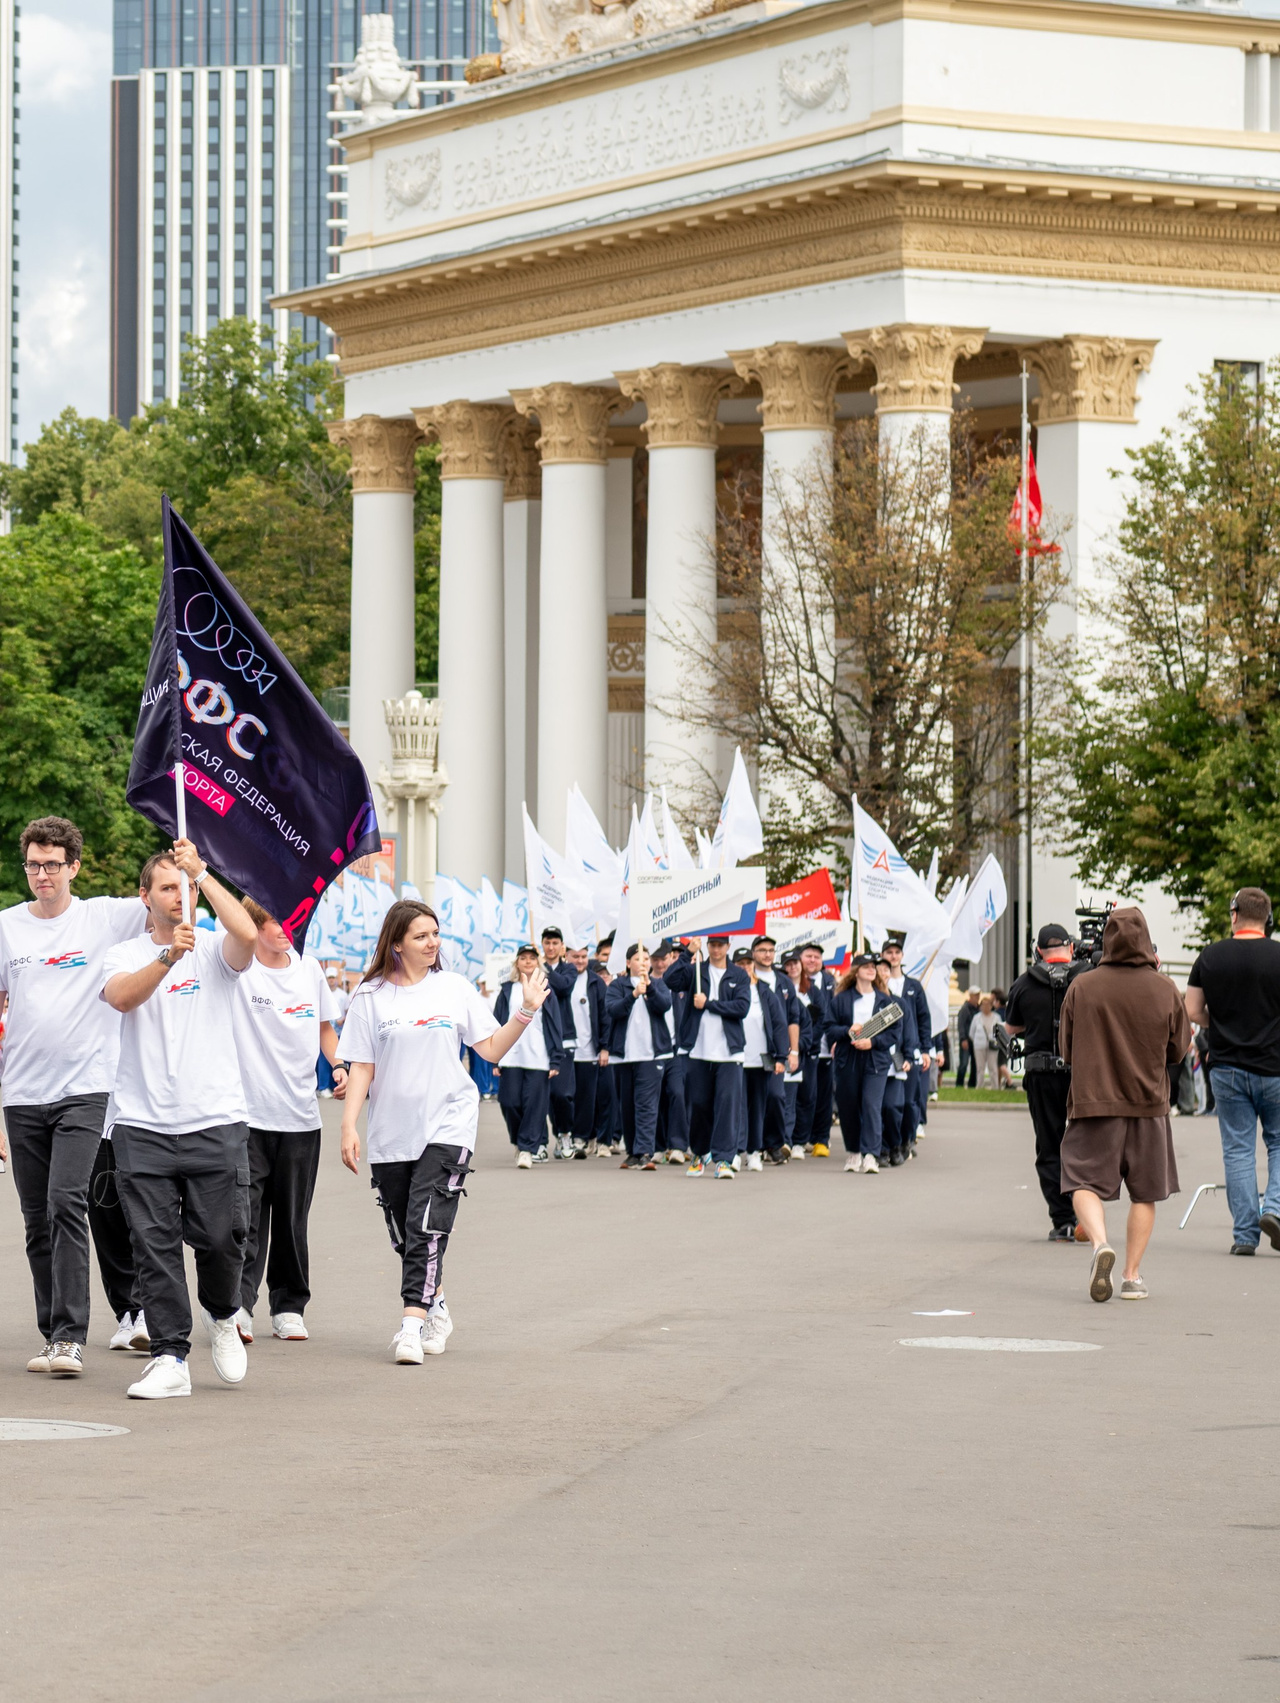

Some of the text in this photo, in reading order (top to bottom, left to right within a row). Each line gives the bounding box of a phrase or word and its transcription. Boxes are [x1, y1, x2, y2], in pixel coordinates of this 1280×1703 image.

[223, 768, 311, 857] ФЕДЕРАЦИЯ
[652, 873, 721, 920] КОМПЬЮТЕРНЫЙ
[652, 911, 678, 934] СПОРТ
